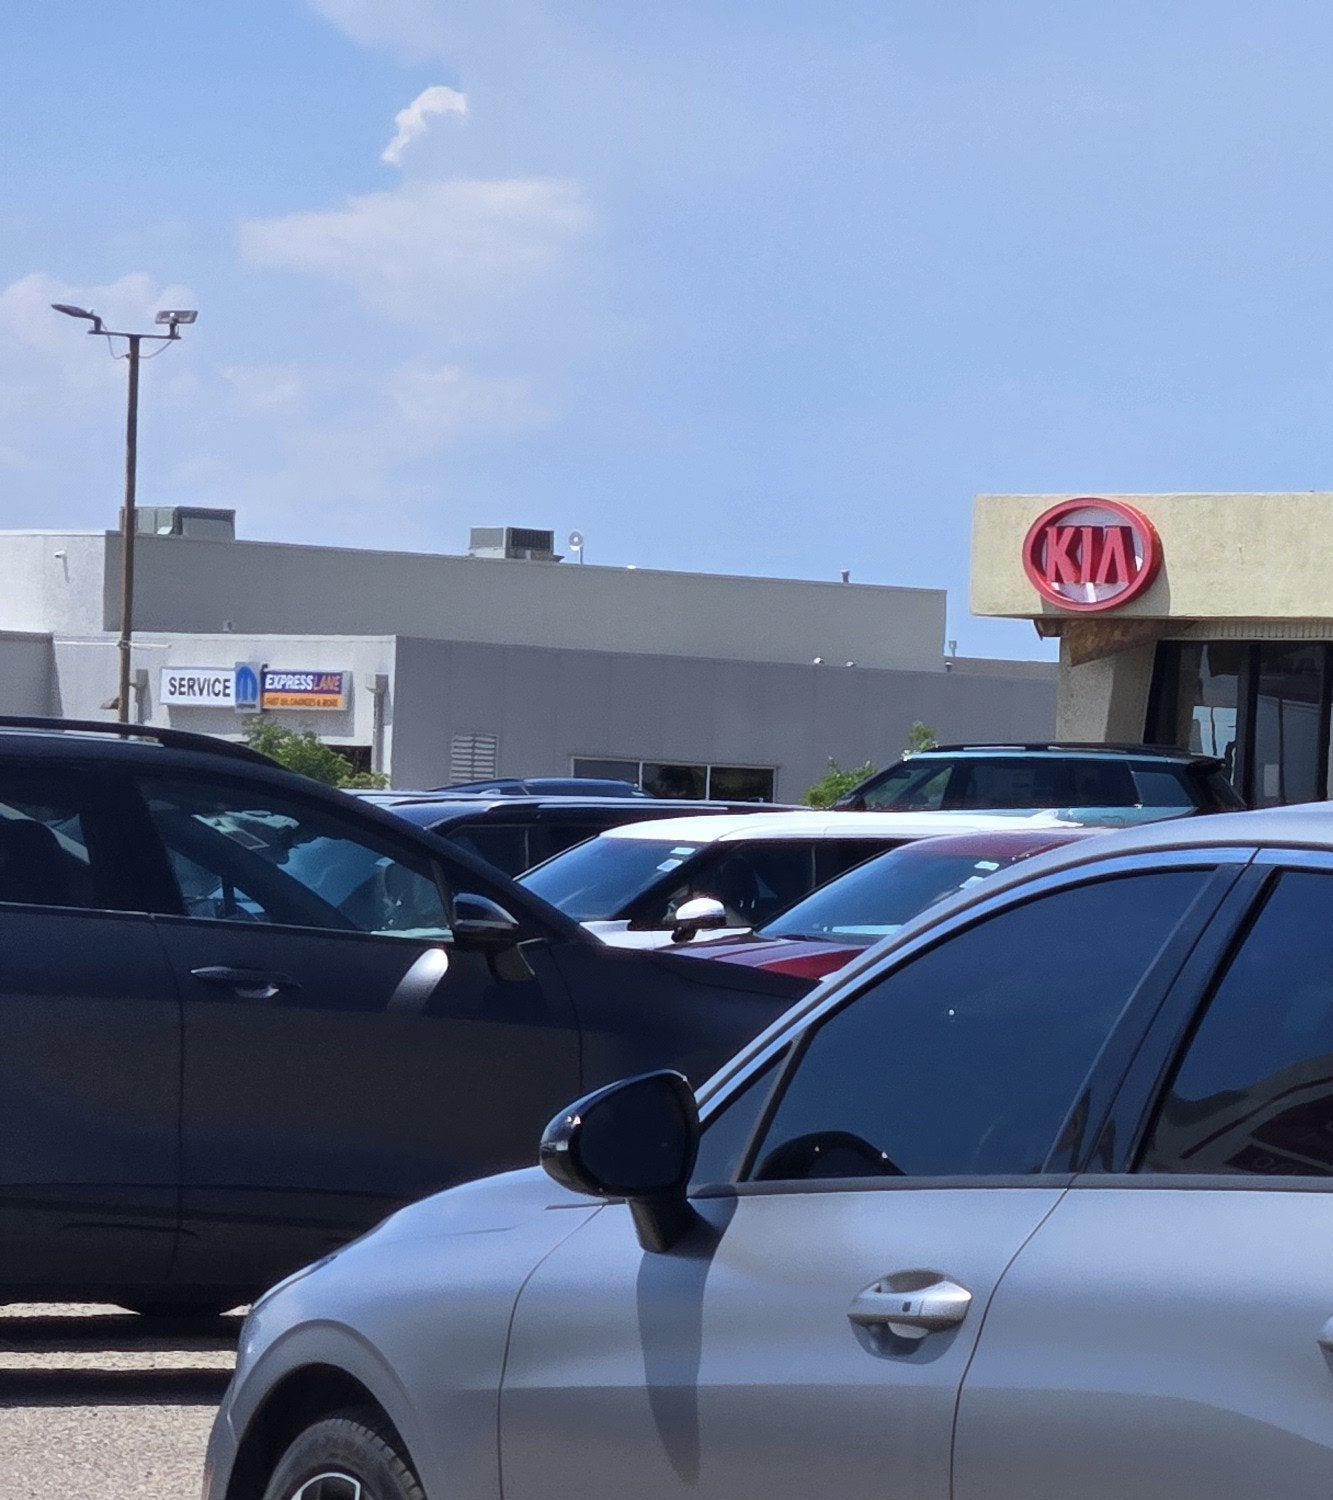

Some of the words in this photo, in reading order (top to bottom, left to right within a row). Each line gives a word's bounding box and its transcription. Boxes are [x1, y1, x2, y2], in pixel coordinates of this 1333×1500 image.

[1045, 524, 1132, 584] KIA
[168, 676, 231, 698] SERVICE
[265, 674, 313, 690] EXPRESS
[313, 675, 341, 691] LANE
